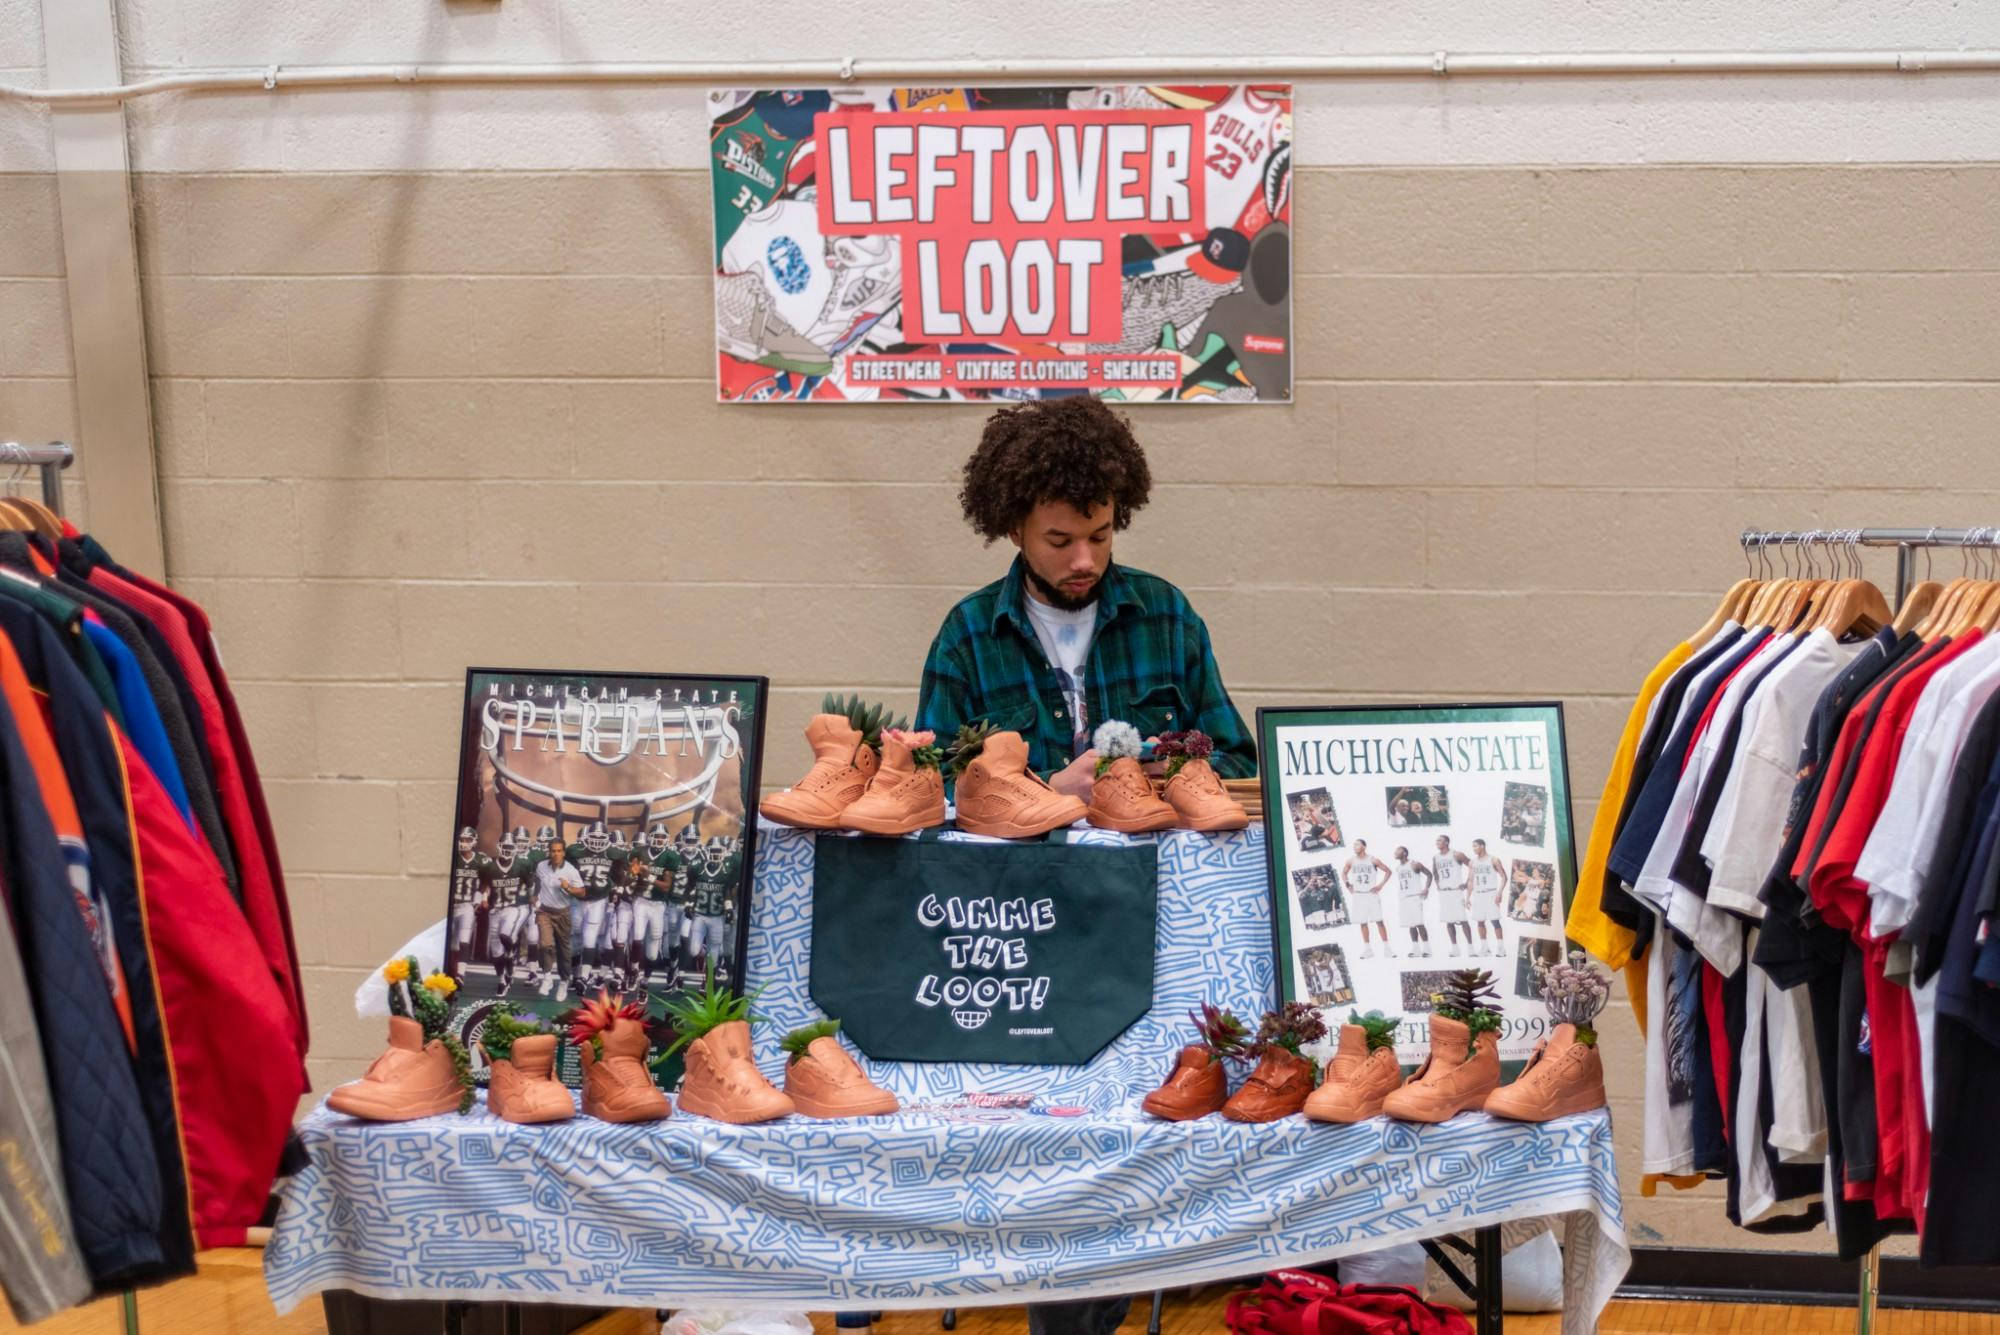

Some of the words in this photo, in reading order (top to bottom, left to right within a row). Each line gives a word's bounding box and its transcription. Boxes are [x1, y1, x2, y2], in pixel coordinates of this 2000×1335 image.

[1209, 114, 1265, 164] BULLS
[828, 124, 1192, 224] LEFTOVER
[1205, 143, 1243, 180] 23
[917, 238, 1103, 336] LOOT
[852, 360, 942, 381] STREETWEAR
[956, 360, 1017, 381] VINTAGE
[1019, 360, 1089, 381] CLOTHING
[1102, 360, 1177, 381] SNEAKERS
[490, 682, 629, 700] MICHIGAN
[655, 687, 738, 703] STATE
[479, 698, 741, 760] SPARTANS
[579, 865, 610, 888] 75
[1357, 874, 1370, 885] 42
[917, 894, 1056, 931] GIMME
[943, 935, 1029, 969] THE
[915, 974, 1050, 1010] LOOT!
[1499, 1016, 1545, 1041] 999
